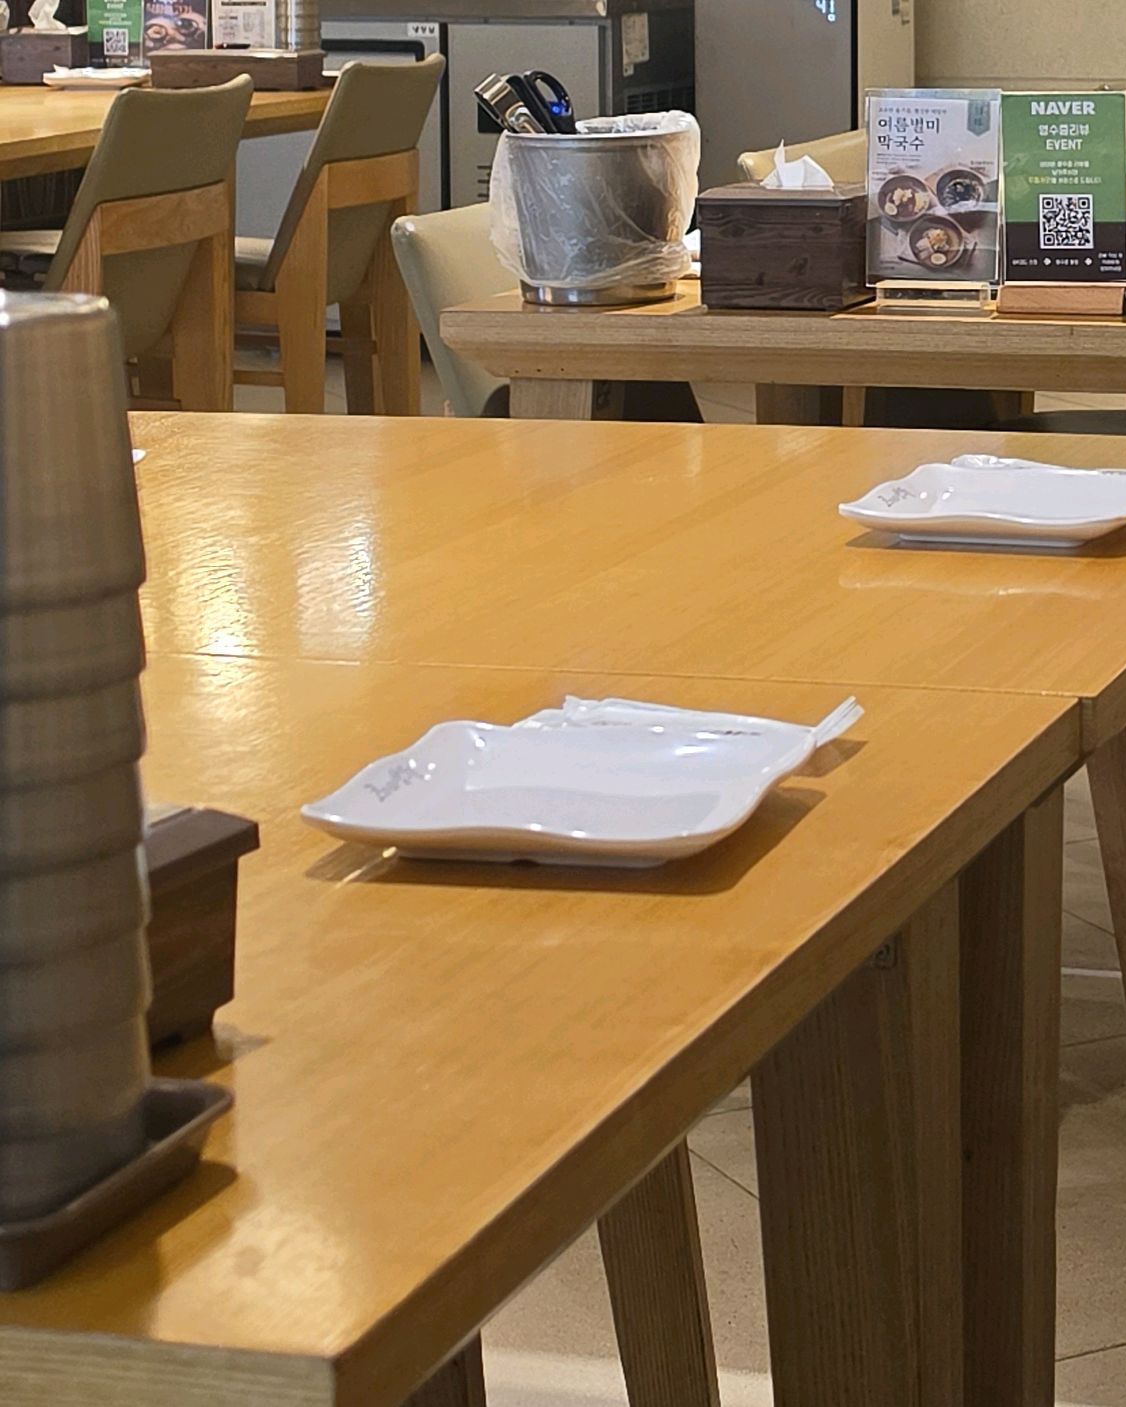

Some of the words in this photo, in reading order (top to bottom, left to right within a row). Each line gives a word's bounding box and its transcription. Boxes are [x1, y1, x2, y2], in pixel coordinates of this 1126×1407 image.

[1031, 101, 1096, 115] NAVER
[877, 135, 925, 151] 막국수
[1046, 139, 1083, 150] EVENT
